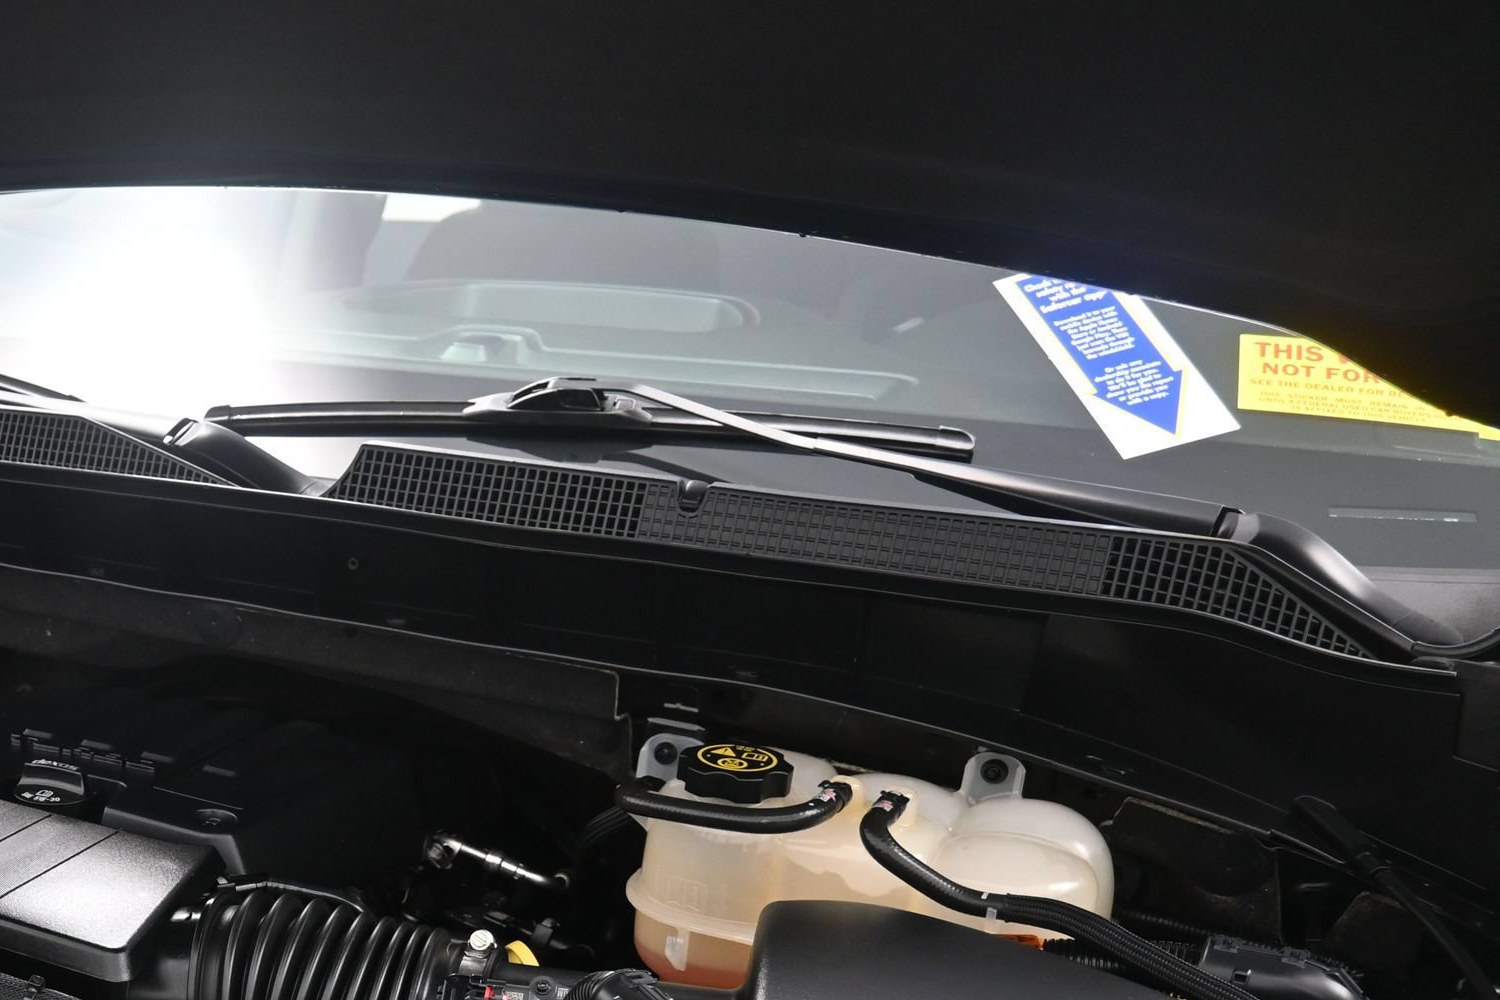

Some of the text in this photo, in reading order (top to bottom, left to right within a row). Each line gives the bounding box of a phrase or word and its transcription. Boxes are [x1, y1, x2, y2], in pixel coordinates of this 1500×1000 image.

[1048, 285, 1087, 303] with the
[1053, 313, 1087, 327] Download
[1100, 306, 1115, 315] your
[1059, 310, 1118, 331] mobile device with
[1066, 326, 1079, 335] the
[1078, 323, 1099, 332] Apple
[1070, 329, 1089, 340] Store
[1096, 321, 1123, 333] Android
[1071, 334, 1095, 346] Google
[1081, 336, 1135, 355] barcode through
[1089, 339, 1105, 347] scan
[1253, 340, 1325, 363] THIS
[1094, 361, 1161, 383] dealership associate
[1115, 363, 1128, 371] ask
[1261, 360, 1381, 384] NOT FOR
[1106, 390, 1125, 399] show
[1125, 386, 1140, 394] you
[1152, 376, 1174, 386] report
[1137, 374, 1154, 385] glad
[1249, 377, 1273, 386] SEE
[1277, 380, 1301, 388] THE
[1304, 382, 1354, 393] DEALER
[1358, 387, 1384, 396] FOR
[1127, 388, 1154, 400] provide
[1154, 385, 1168, 393] you
[1127, 397, 1143, 405] with
[1287, 392, 1328, 402] STICKER
[1369, 400, 1408, 409] REMAIN
[1296, 399, 1339, 408] FEDERAL
[1342, 403, 1368, 411] USED
[1305, 406, 1344, 414] AFFIXED
[32, 759, 76, 770] dexos
